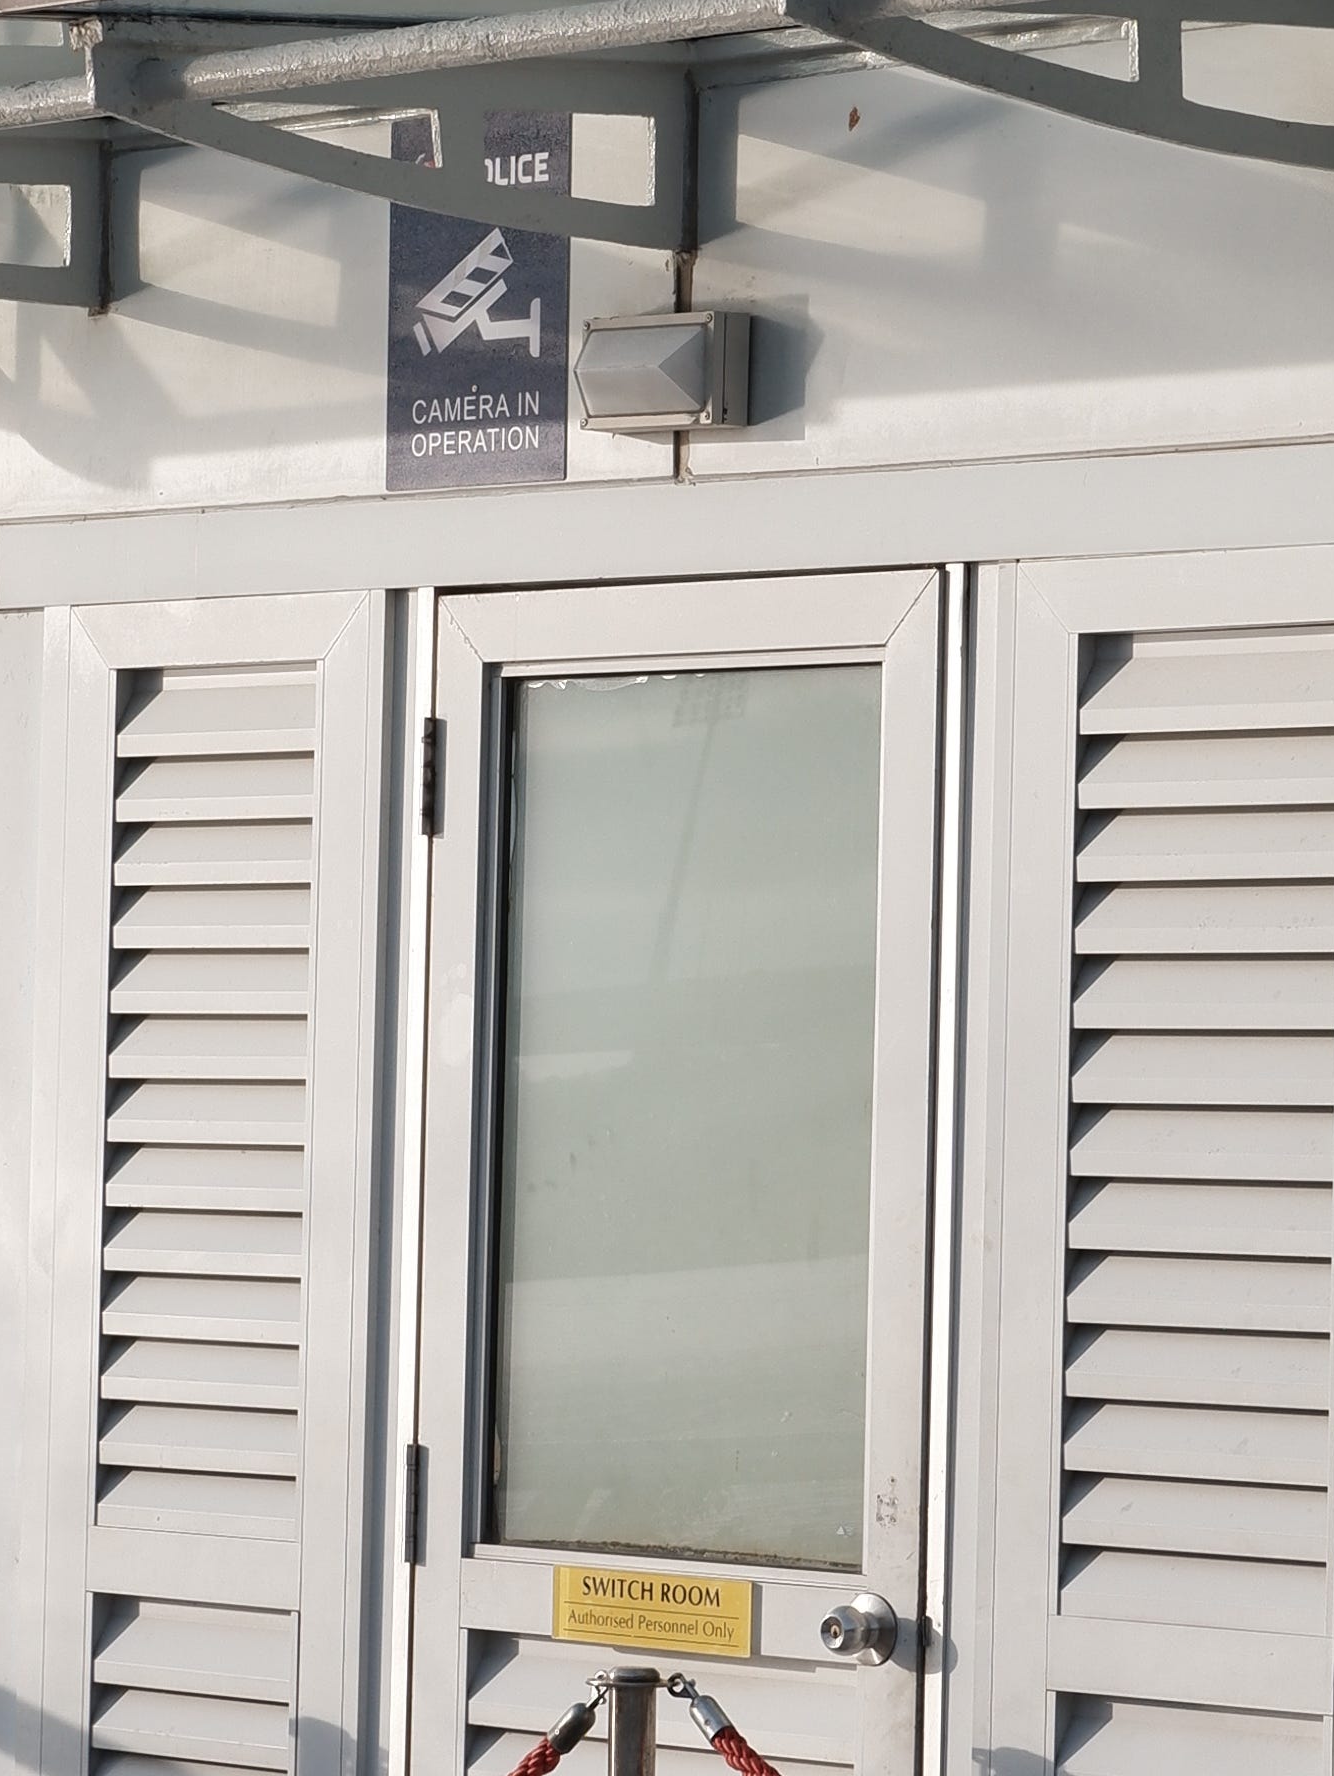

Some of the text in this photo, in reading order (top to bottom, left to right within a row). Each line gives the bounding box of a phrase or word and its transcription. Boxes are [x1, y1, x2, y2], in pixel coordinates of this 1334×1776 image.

[412, 390, 539, 424] CAMERA IN
[411, 425, 539, 457] OPERATION
[582, 1575, 720, 1607] SWITCH ROOM
[568, 1608, 734, 1642] Authorised Personnel Only
